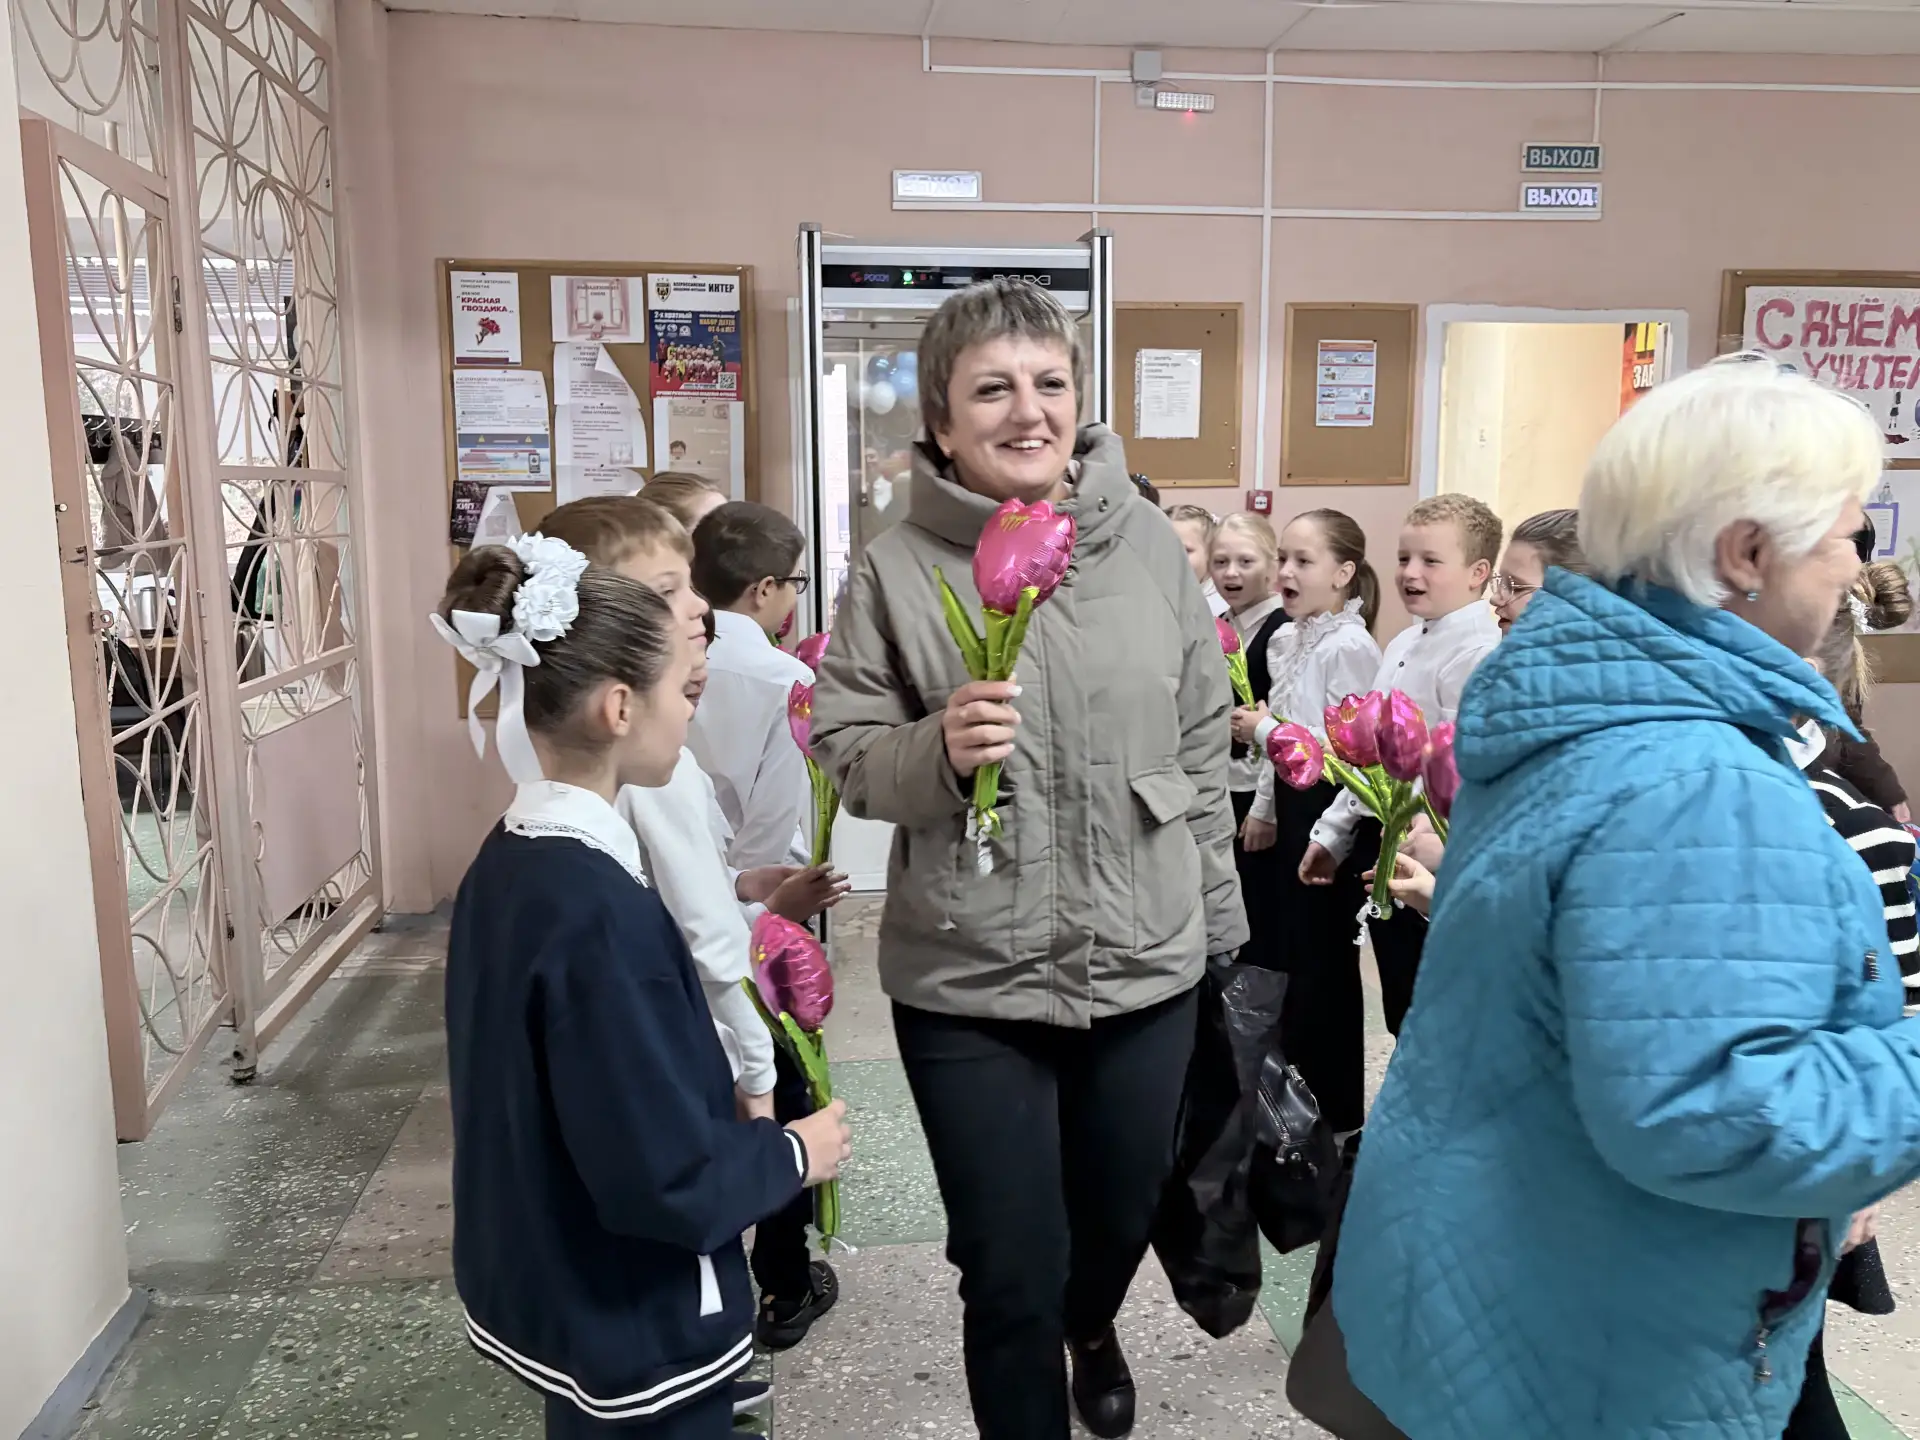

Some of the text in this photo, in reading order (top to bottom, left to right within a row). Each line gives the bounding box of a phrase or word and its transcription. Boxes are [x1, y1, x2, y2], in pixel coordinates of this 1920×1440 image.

[1529, 148, 1595, 168] ВЫХОД
[1527, 188, 1594, 206] ВЫХОД
[708, 283, 735, 293] ИНТЕР
[1756, 297, 1920, 350] С ДНЁМ
